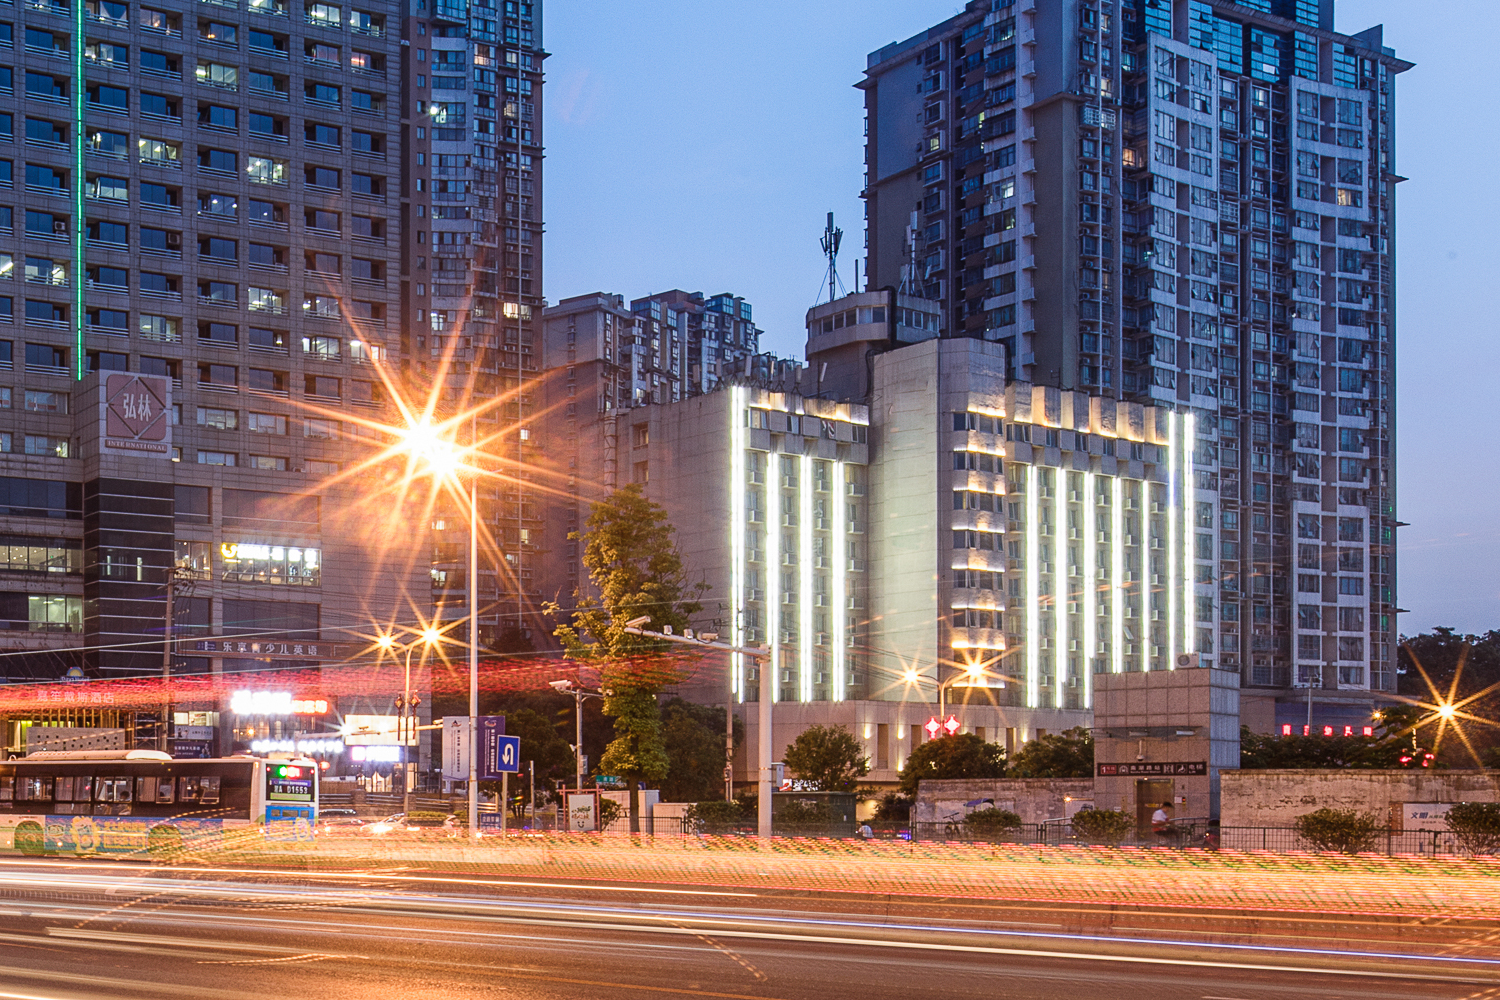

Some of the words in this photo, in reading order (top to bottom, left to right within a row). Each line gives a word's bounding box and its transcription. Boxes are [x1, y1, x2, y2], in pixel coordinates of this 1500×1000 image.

[123, 392, 152, 422] 弘林
[107, 440, 167, 451] INTERNATIONAL
[36, 690, 115, 704] 嘉笙戴斯酒店
